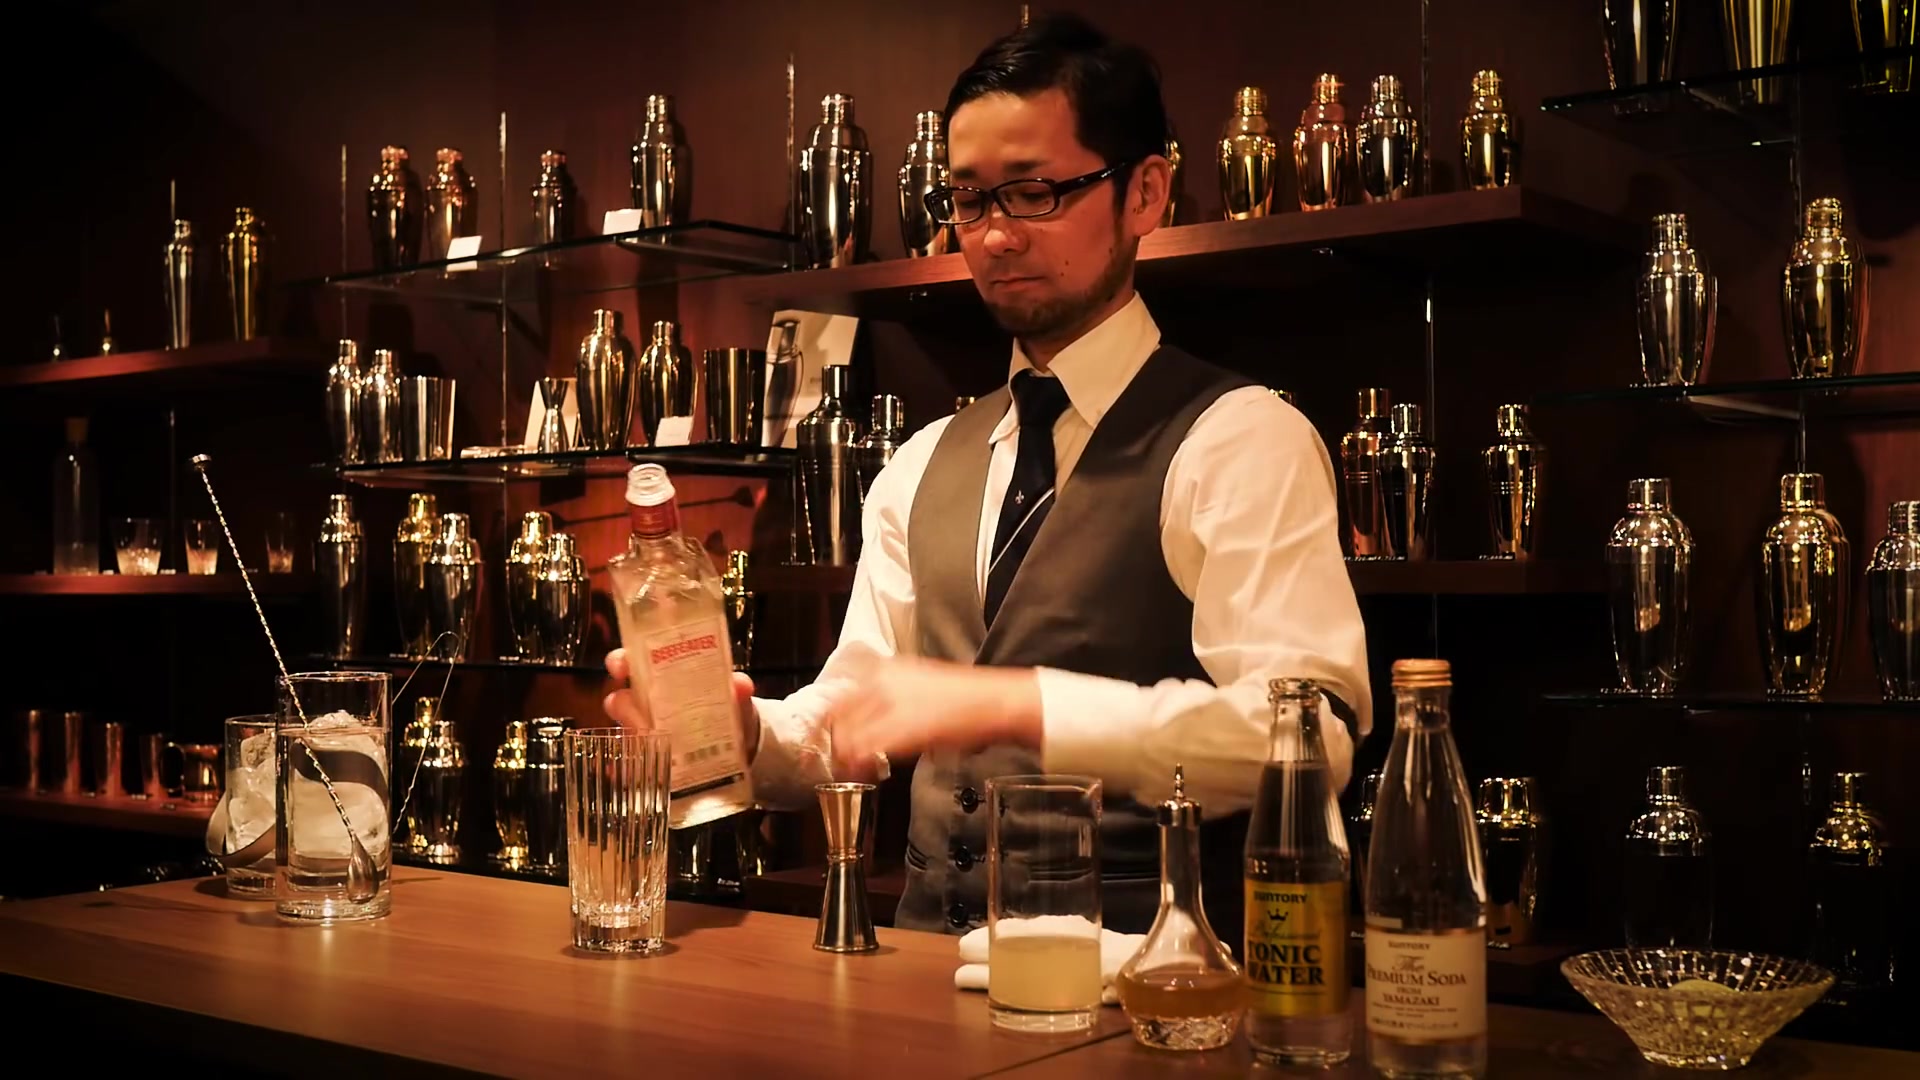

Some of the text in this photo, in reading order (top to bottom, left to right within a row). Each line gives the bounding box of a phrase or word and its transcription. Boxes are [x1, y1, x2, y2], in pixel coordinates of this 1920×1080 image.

[652, 635, 717, 663] BEEFEATER
[1247, 940, 1321, 965] TONIC
[1426, 970, 1467, 986] SODA
[1382, 993, 1440, 1006] YAMAZAKI
